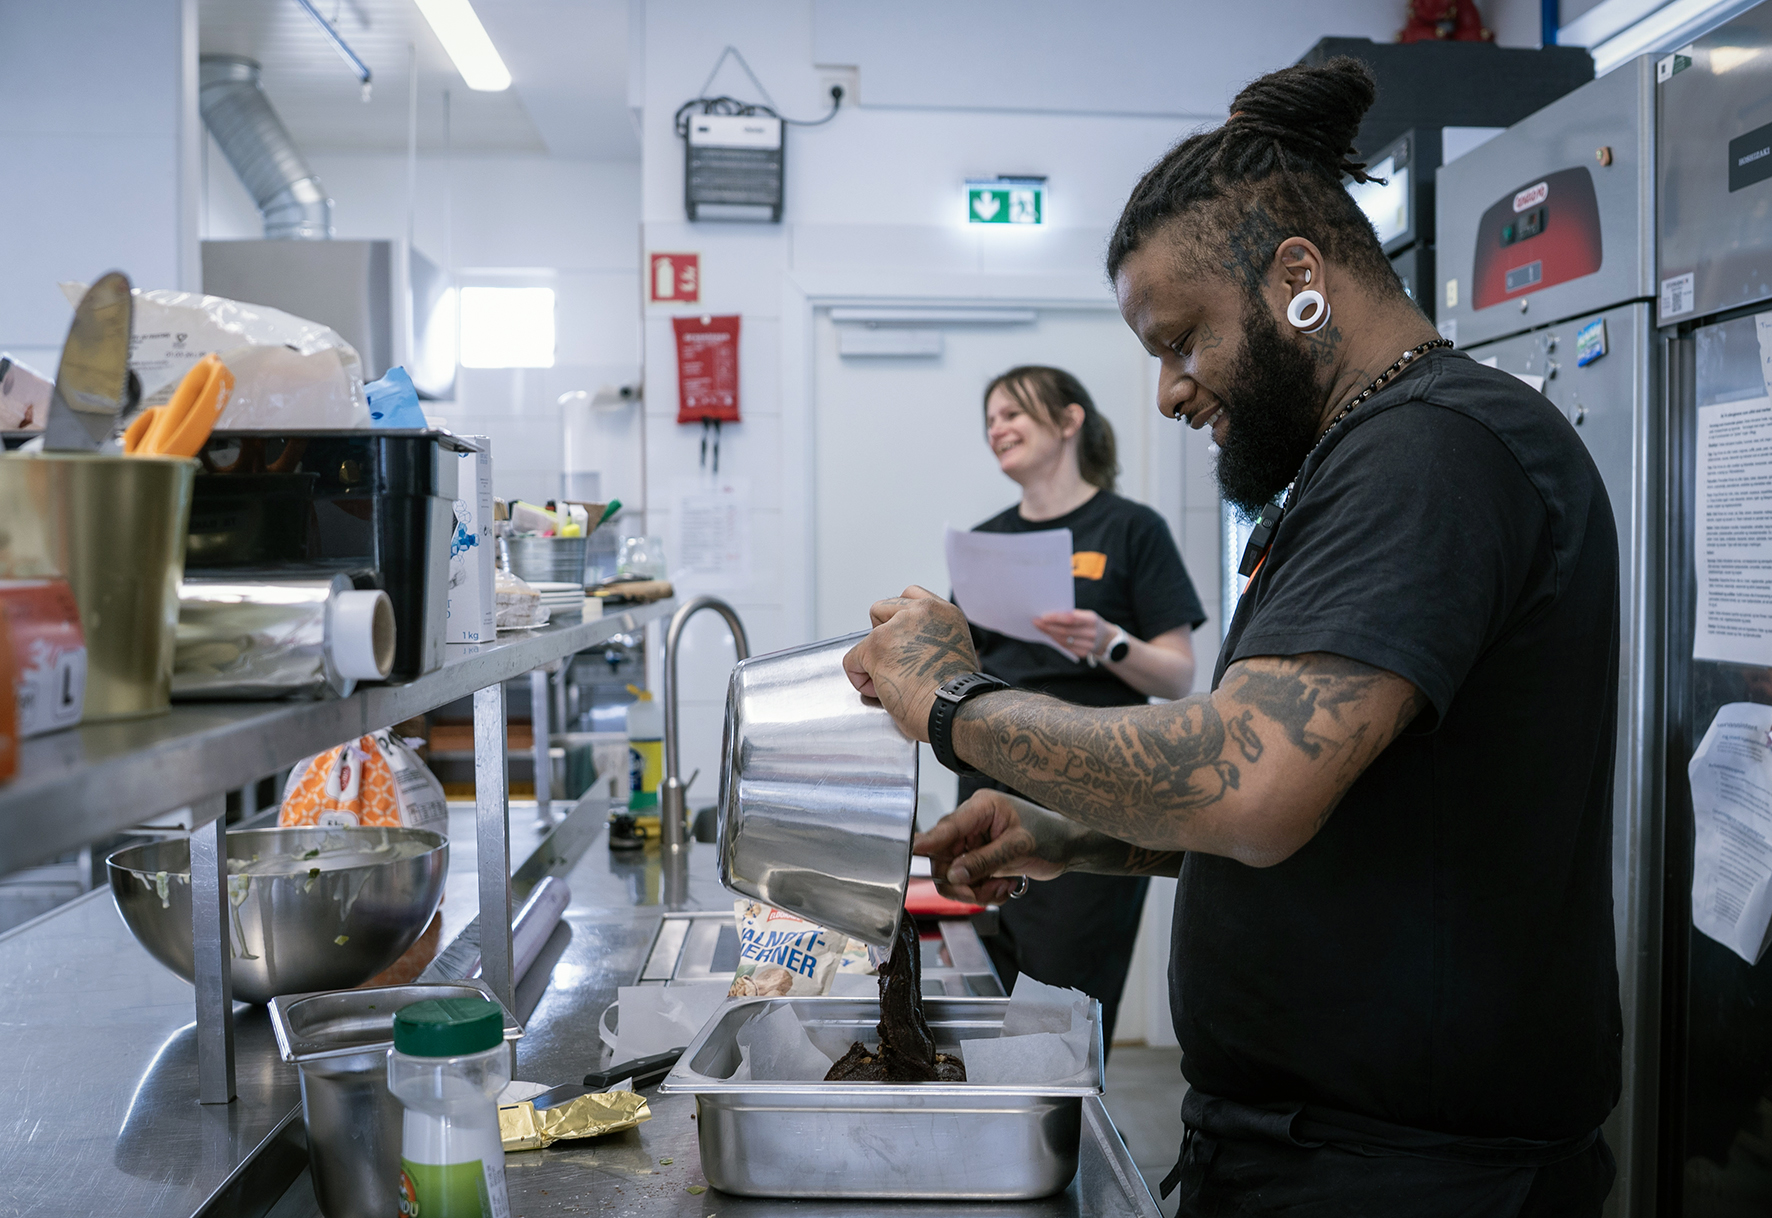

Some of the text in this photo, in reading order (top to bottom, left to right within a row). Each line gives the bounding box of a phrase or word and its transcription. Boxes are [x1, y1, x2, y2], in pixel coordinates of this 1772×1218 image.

[1738, 146, 1770, 167] HOSHIZAKI
[463, 631, 478, 641] 1 kg
[1007, 734, 1117, 792] One Love
